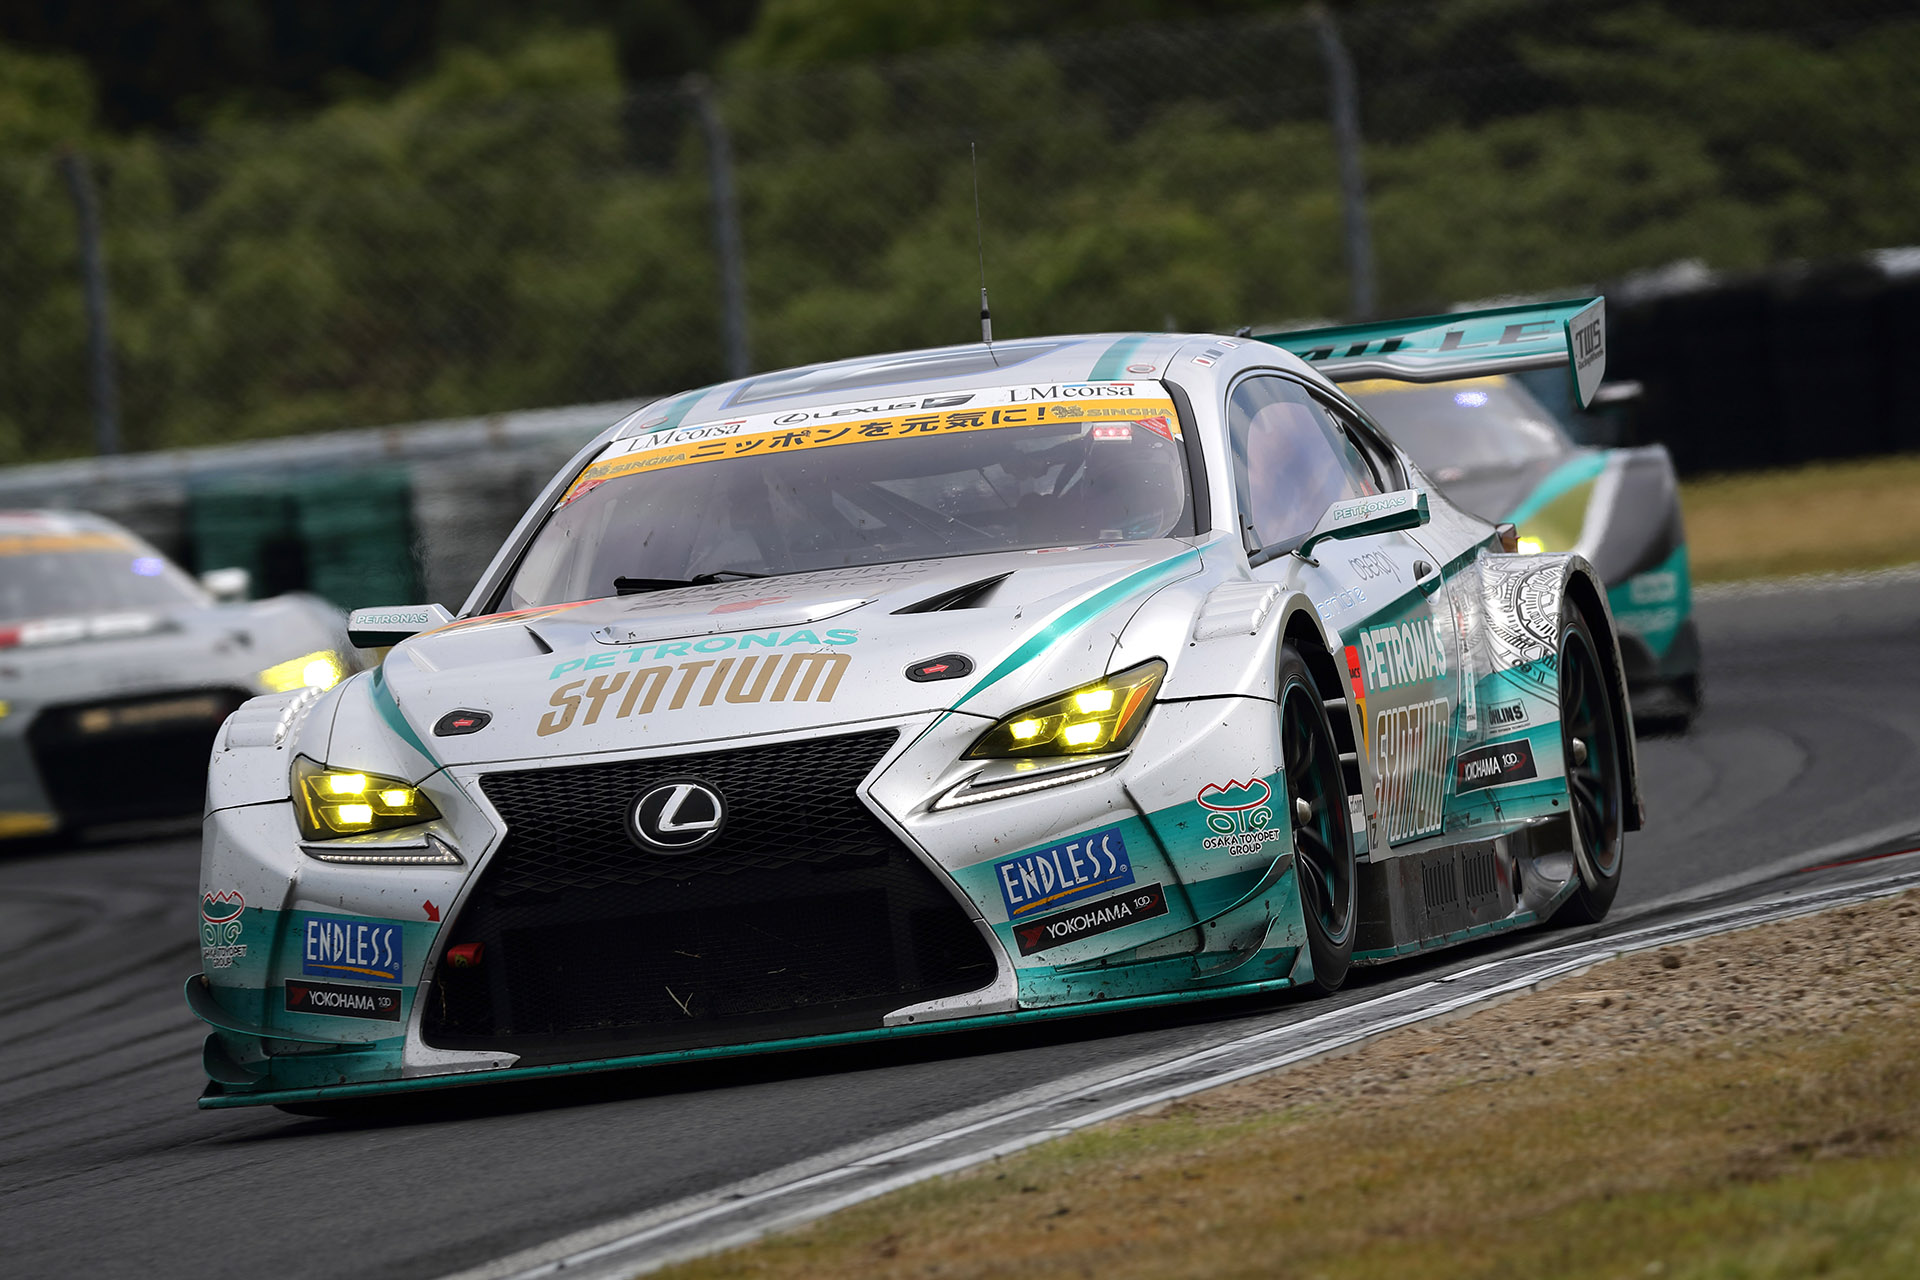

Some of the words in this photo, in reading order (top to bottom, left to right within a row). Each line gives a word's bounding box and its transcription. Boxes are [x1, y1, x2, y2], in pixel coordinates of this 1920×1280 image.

[1575, 319, 1601, 359] TWS
[814, 402, 917, 418] LEXUS
[1086, 408, 1177, 417] SINGHA
[611, 453, 686, 474] SINGHA
[1333, 496, 1407, 521] PETRONAS
[356, 612, 429, 625] PETRONAS
[548, 629, 860, 681] PETRONAS
[1359, 616, 1447, 692] PETRONAS
[536, 652, 852, 738] SYNTIUM
[1203, 836, 1238, 849] OSAKA
[1239, 829, 1279, 843] TOYOPET
[1229, 843, 1261, 855] GROUP
[999, 834, 1117, 905] ENDLESS
[1046, 902, 1132, 938] YOKOHAMA
[306, 921, 393, 967] ENDLESS
[308, 991, 375, 1010] YOKOHAMA
